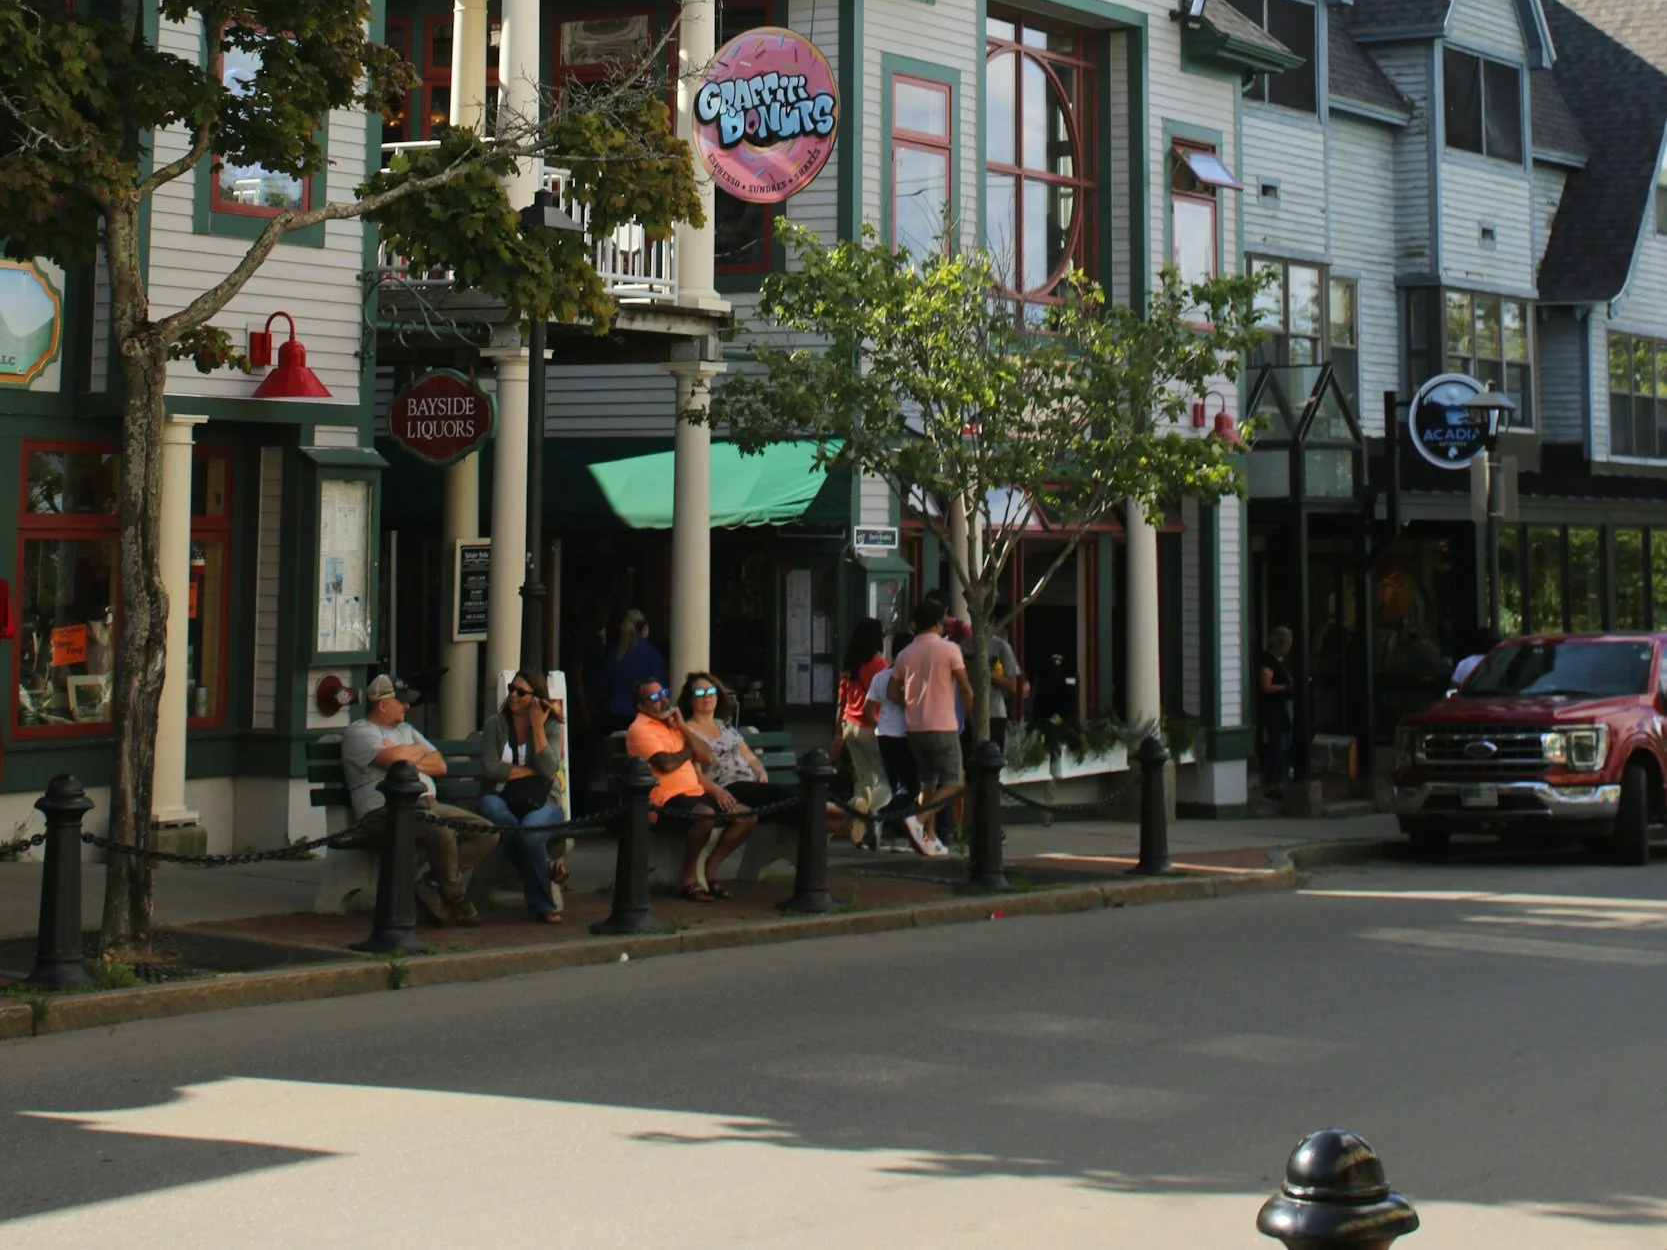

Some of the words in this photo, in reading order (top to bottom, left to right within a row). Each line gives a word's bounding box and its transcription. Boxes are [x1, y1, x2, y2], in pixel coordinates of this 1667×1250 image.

[719, 93, 836, 147] DONUTS
[707, 152, 741, 188] ESPRESSO
[747, 180, 788, 193] SUNDAES
[793, 147, 822, 181] SHAKES
[406, 396, 476, 417] BAYSIDE
[406, 419, 475, 440] LIQUORS
